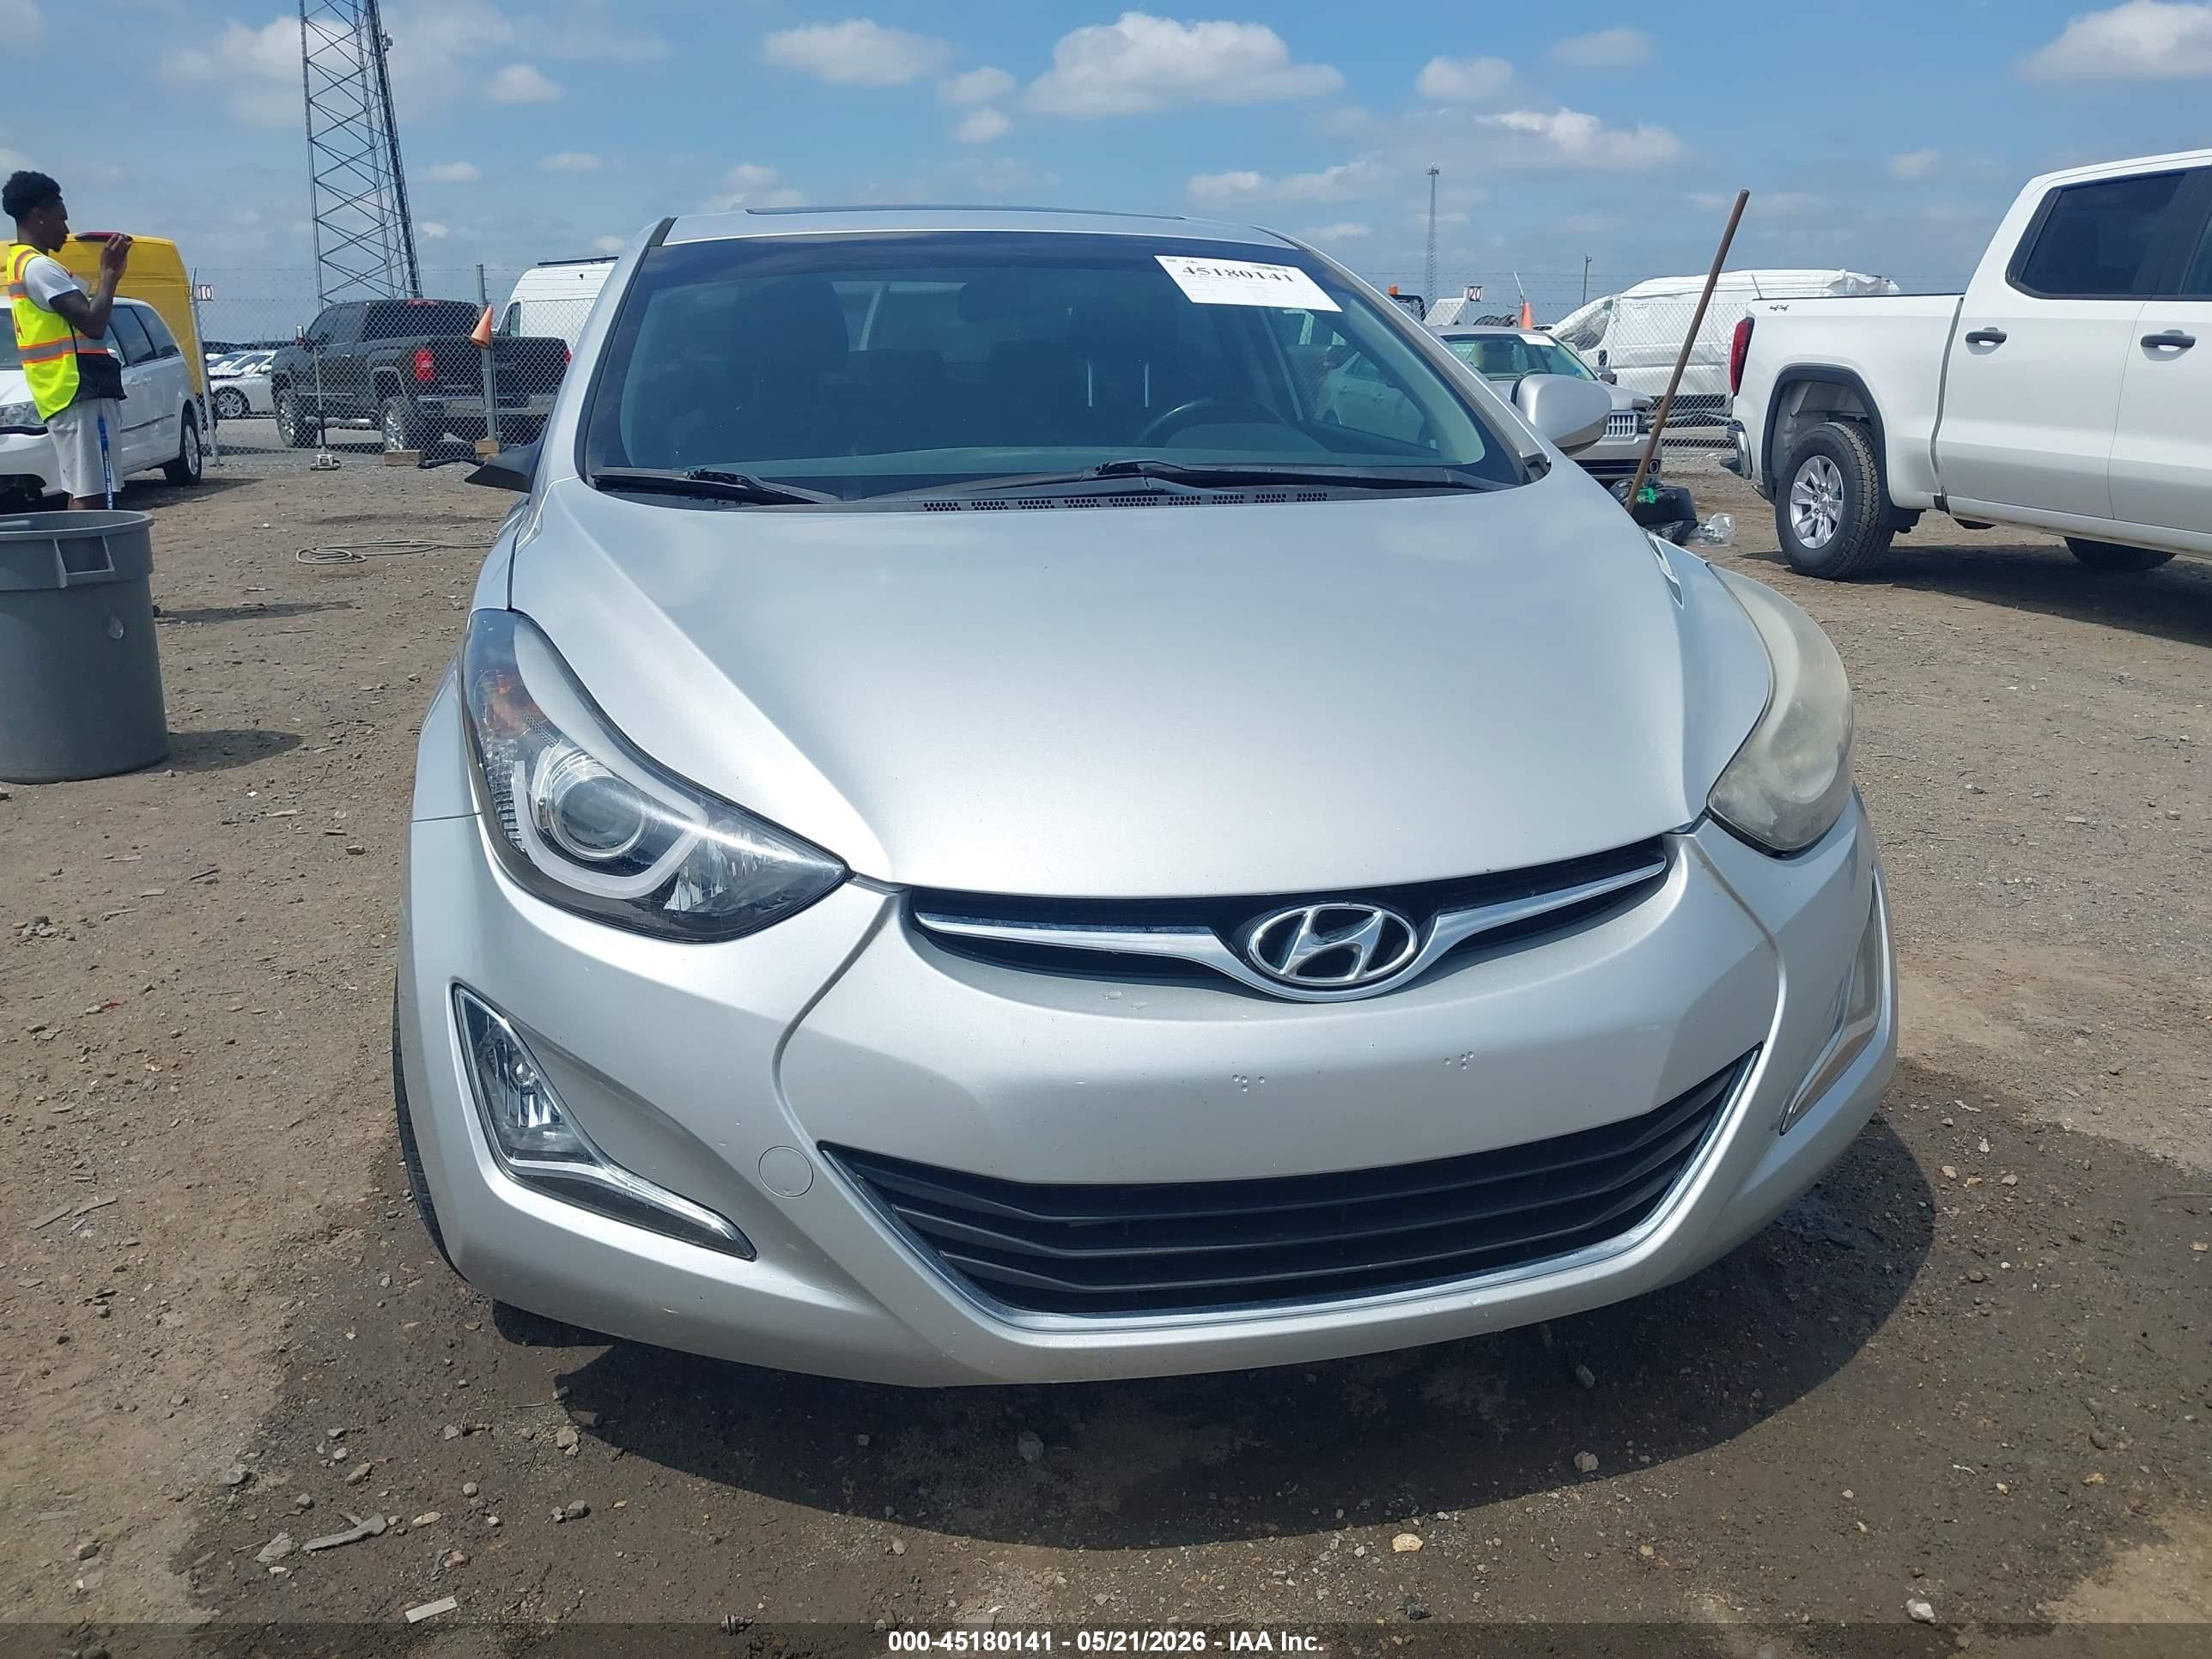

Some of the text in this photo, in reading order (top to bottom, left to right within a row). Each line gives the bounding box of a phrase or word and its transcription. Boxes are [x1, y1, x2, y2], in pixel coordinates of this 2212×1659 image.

[1182, 266, 1294, 283] 45180141
[198, 286, 212, 301] 10
[1469, 288, 1482, 301] 20
